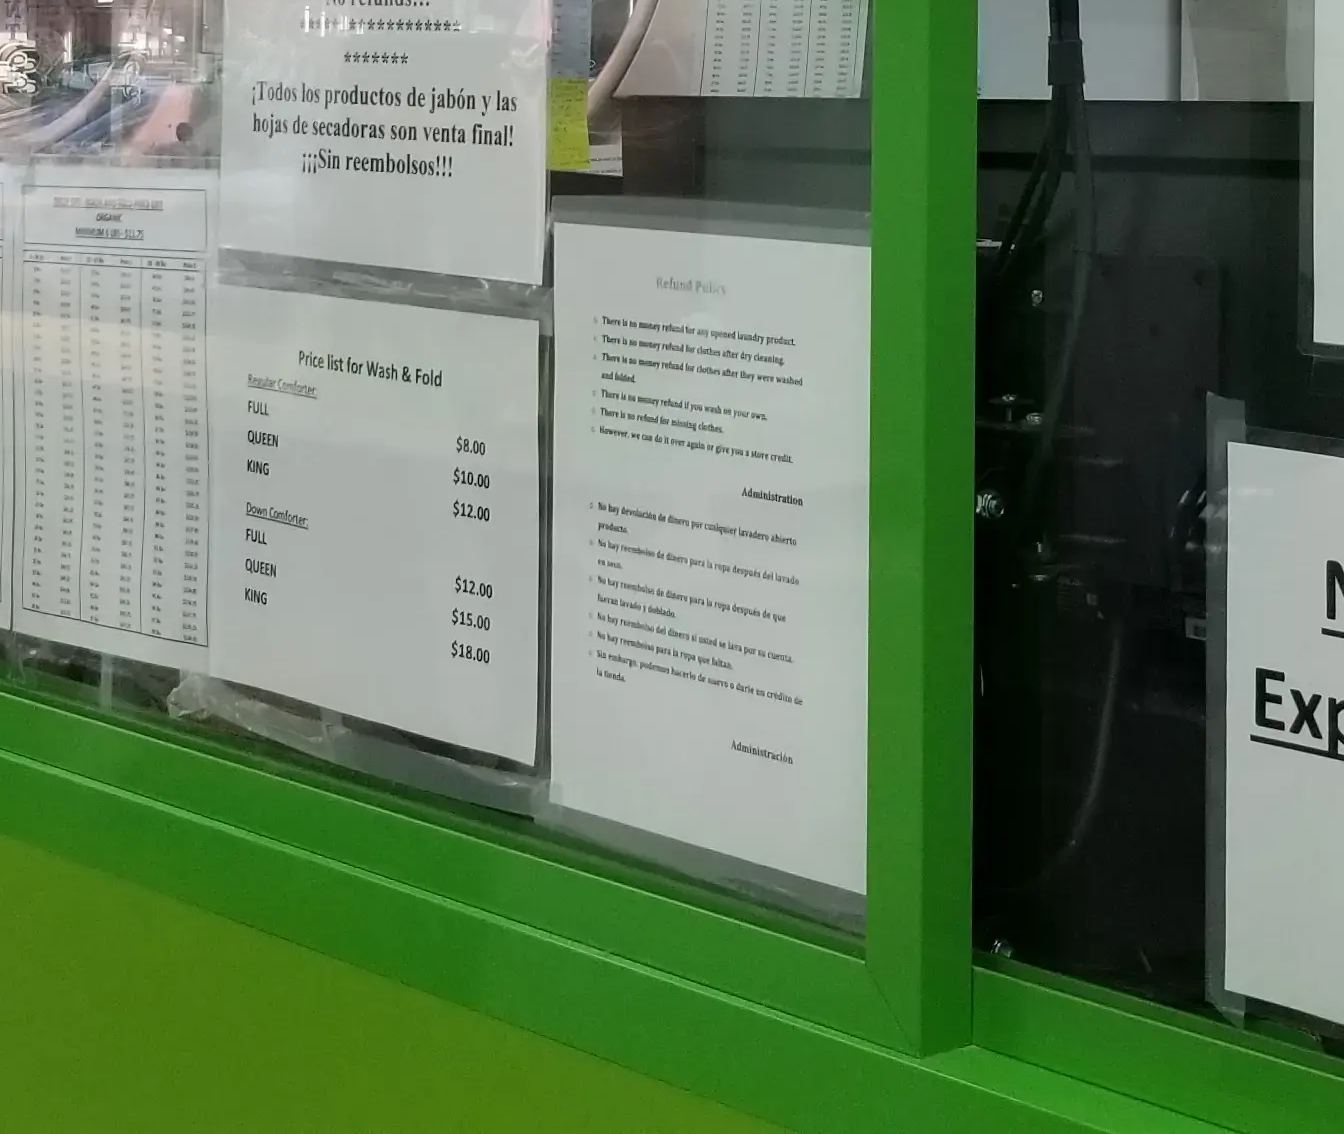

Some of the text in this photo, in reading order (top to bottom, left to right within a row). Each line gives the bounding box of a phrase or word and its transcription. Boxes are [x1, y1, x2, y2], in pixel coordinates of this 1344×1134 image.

[252, 81, 518, 116] ¡Todos los productos de jabón y las
[253, 113, 514, 147] hojas de secadoras son venta final!
[302, 148, 454, 178] ¡¡¡Sin reembolsos!!!
[655, 276, 693, 293] Refund
[298, 350, 442, 387] Price list for Wash & Fold
[247, 374, 276, 390] Regular
[248, 400, 269, 416] FULL
[247, 430, 279, 447] QUEEN
[456, 436, 486, 456] $8.00
[247, 459, 270, 476] KING
[453, 468, 490, 489] $10.00
[741, 487, 803, 506] Administration
[246, 502, 309, 526] Down Comforter:
[453, 500, 490, 522] $12.00
[246, 529, 267, 545] FULL
[245, 558, 277, 577] QUEEN
[244, 588, 268, 605] KING
[455, 576, 493, 599] $12.00
[451, 608, 491, 631] $15.00
[451, 640, 490, 664] $18.00
[731, 739, 793, 765] Administración
